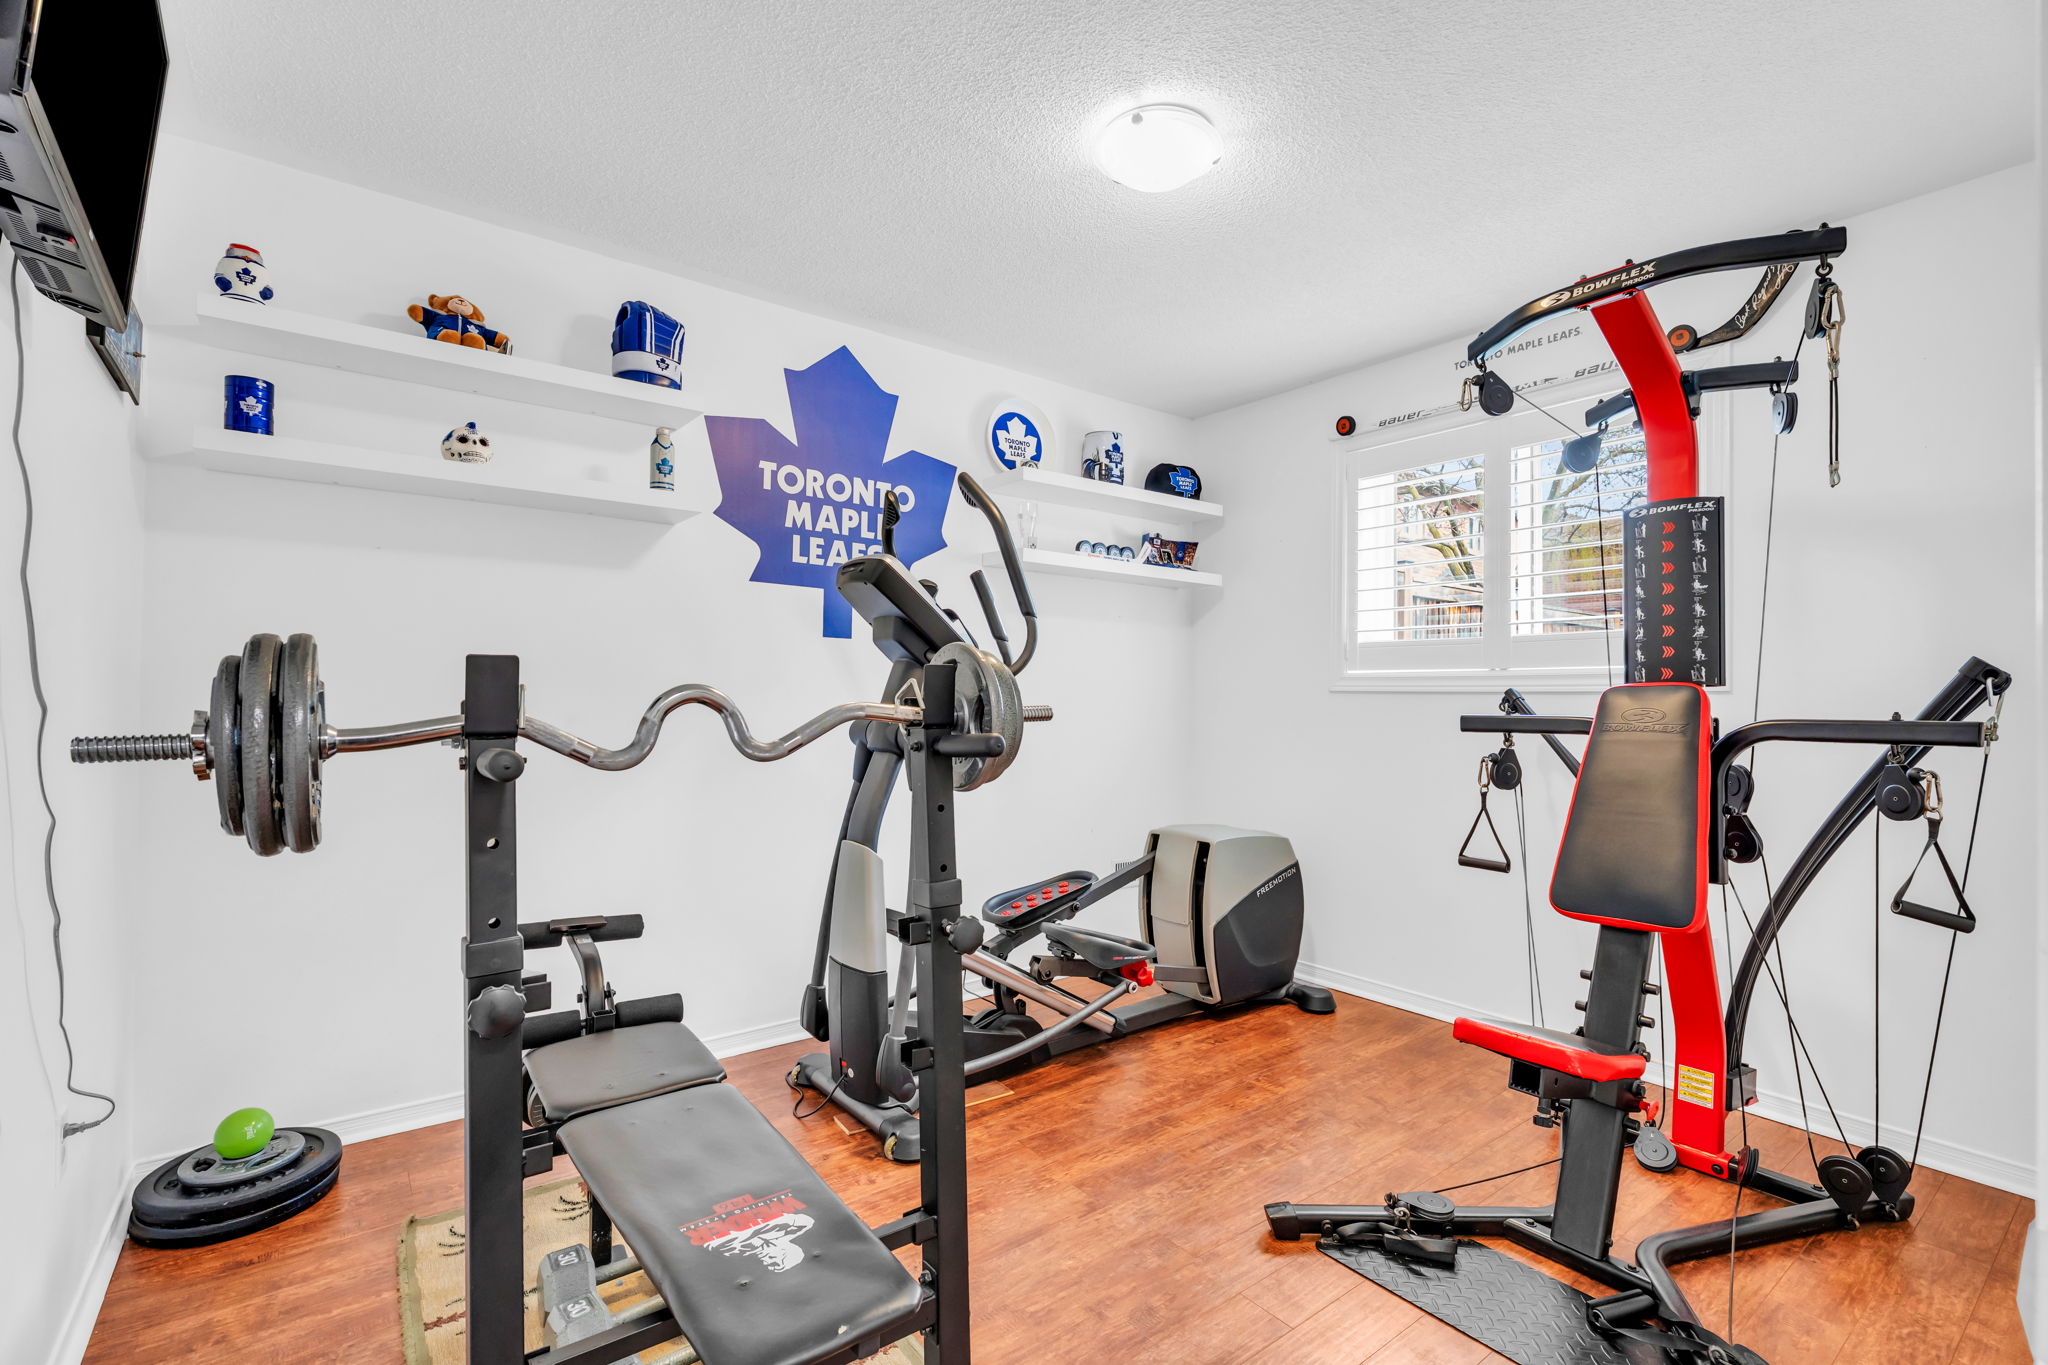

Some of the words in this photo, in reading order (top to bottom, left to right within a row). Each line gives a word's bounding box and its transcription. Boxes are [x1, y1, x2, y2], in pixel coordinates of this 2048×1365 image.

[1572, 261, 1656, 297] BOWFLEX
[1621, 272, 1655, 288] PR3000
[1507, 337, 1543, 355] MAPLE
[1004, 437, 1031, 448] TORONTO
[1008, 444, 1027, 453] MAPLE
[1010, 450, 1026, 459] LEAFS
[758, 460, 916, 513] TORONTO
[1648, 500, 1716, 515] BOWFLEX
[1602, 723, 1689, 735] BOWFLEX
[1256, 867, 1297, 898] FREEMOTION
[734, 1192, 793, 1214] TRAINING
[557, 1251, 580, 1267] 30
[566, 1299, 592, 1319] 30
